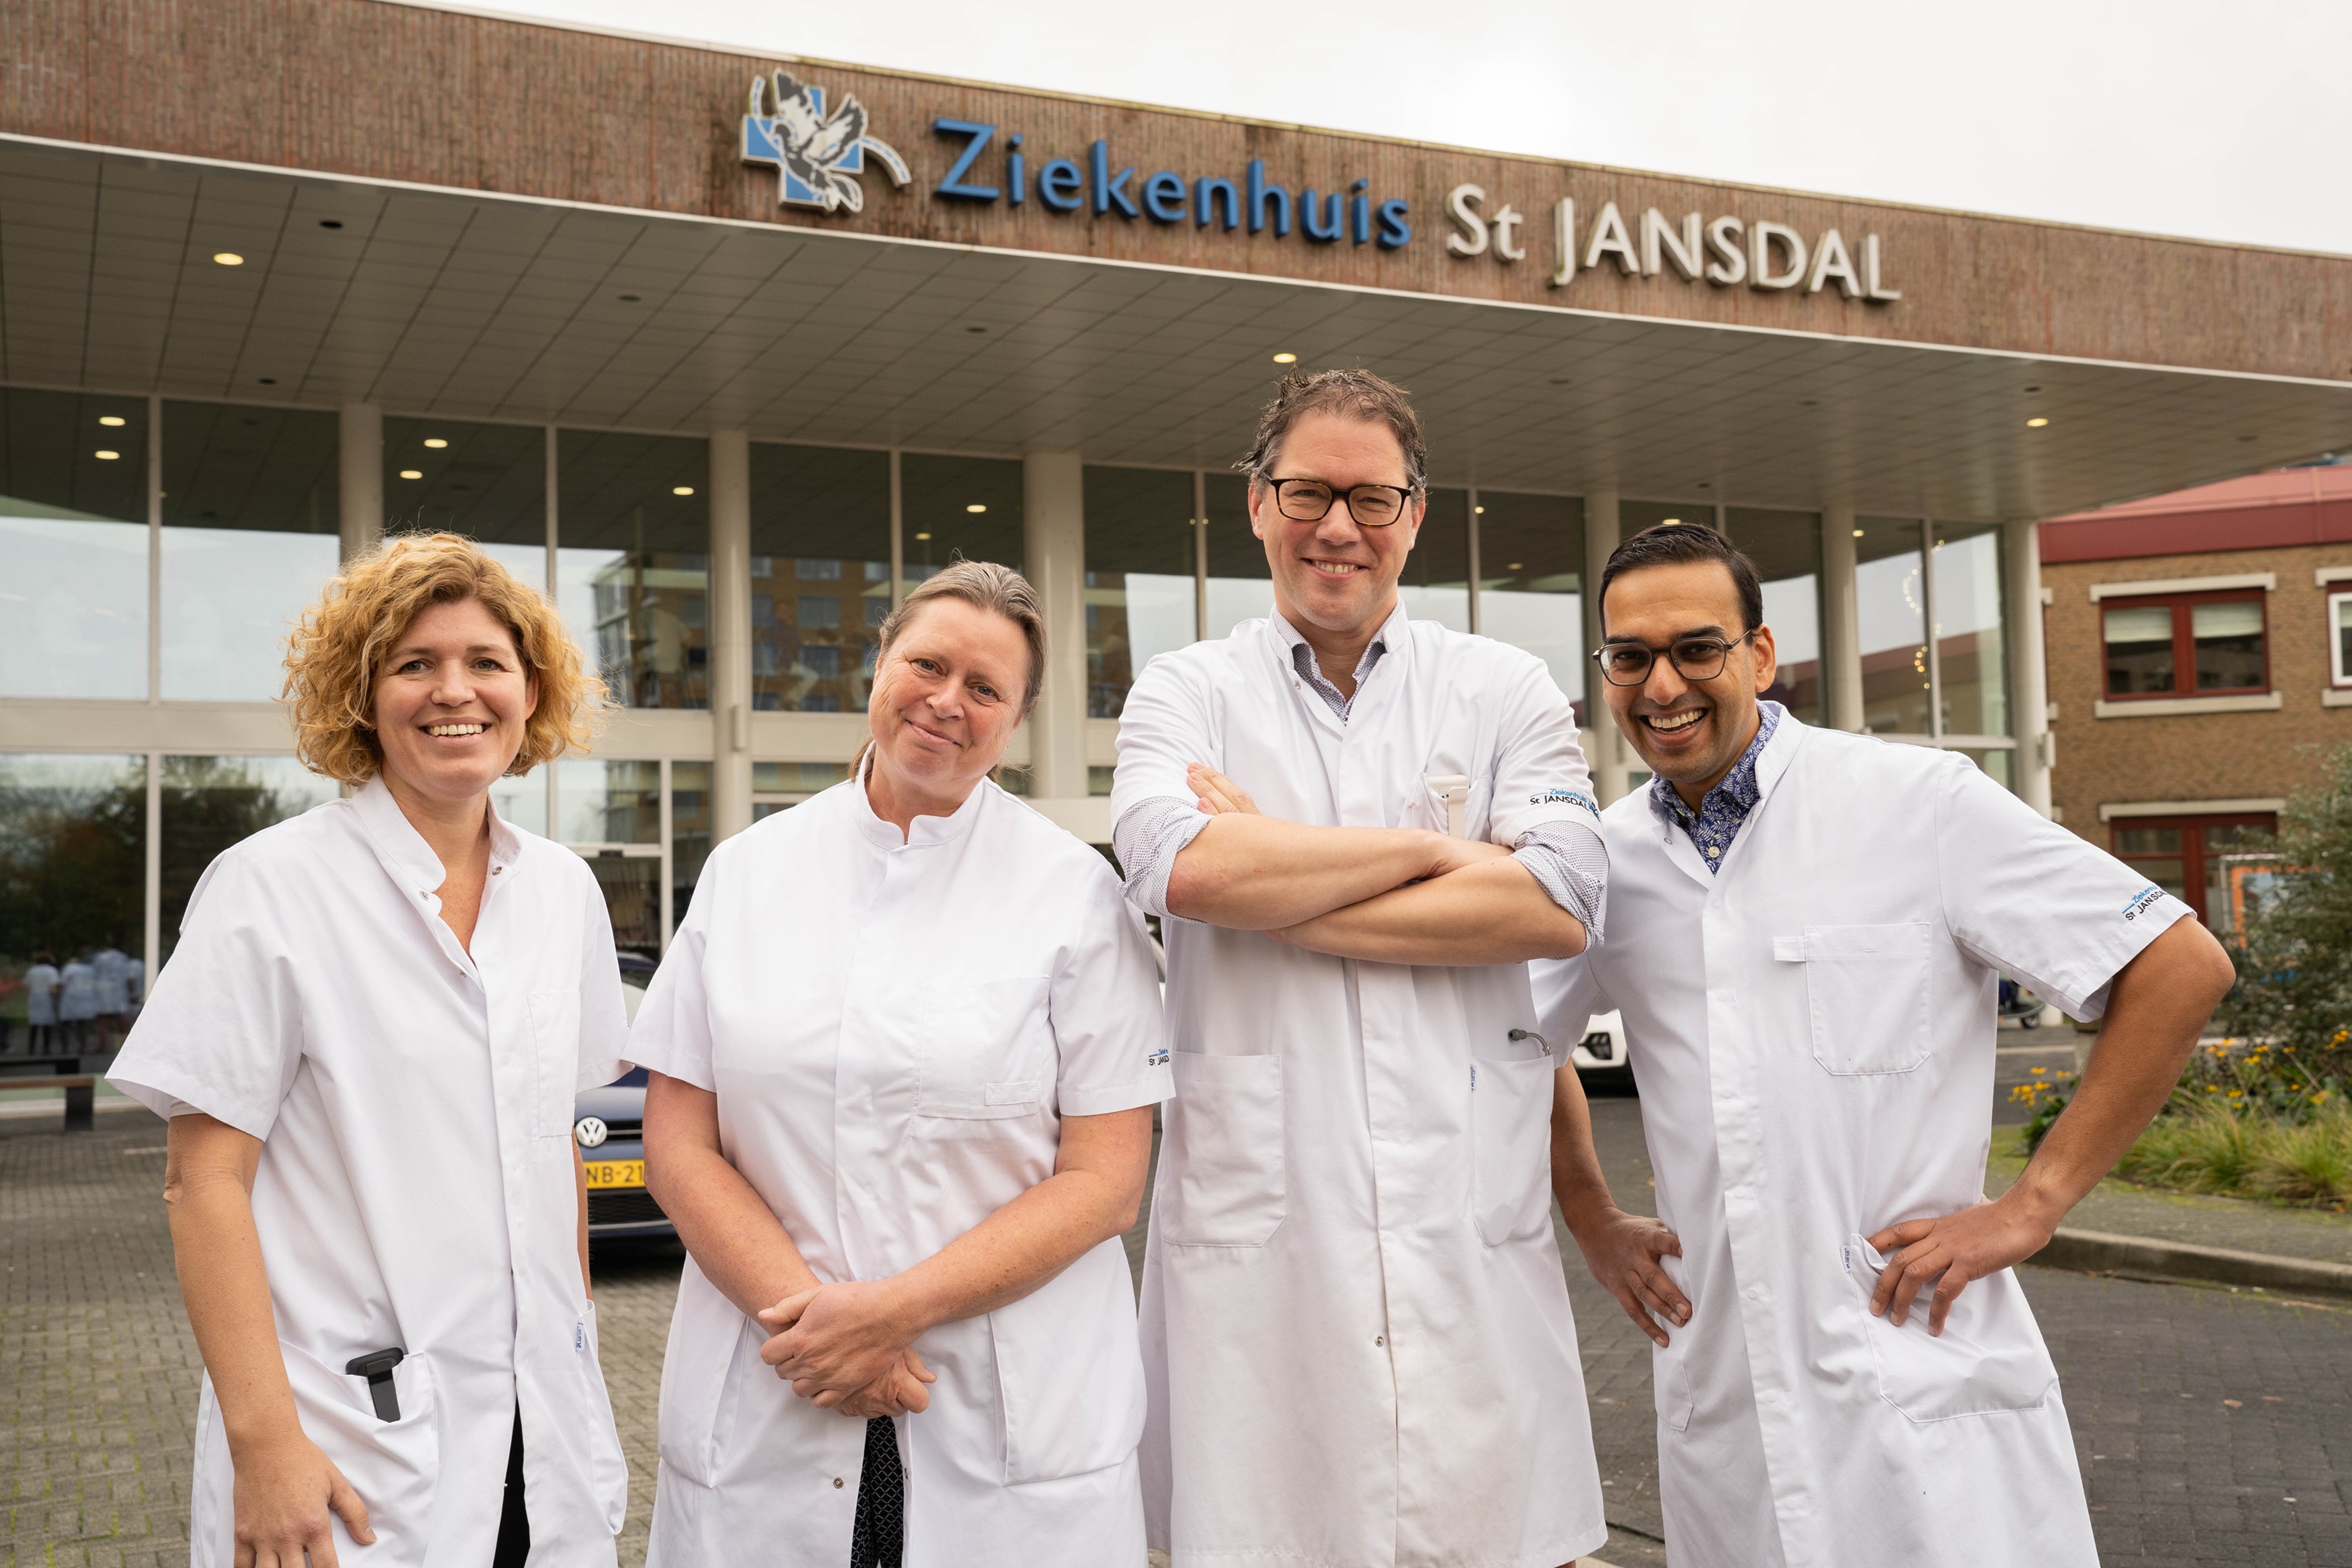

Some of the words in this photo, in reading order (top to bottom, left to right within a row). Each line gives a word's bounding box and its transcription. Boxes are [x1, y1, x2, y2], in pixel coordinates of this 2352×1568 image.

[933, 118, 1411, 248] Ziekenhuis
[1445, 183, 1525, 263] St
[1547, 196, 1901, 302] JANSDAL
[1544, 795, 1590, 812] JANSDAL
[2126, 911, 2136, 920] St
